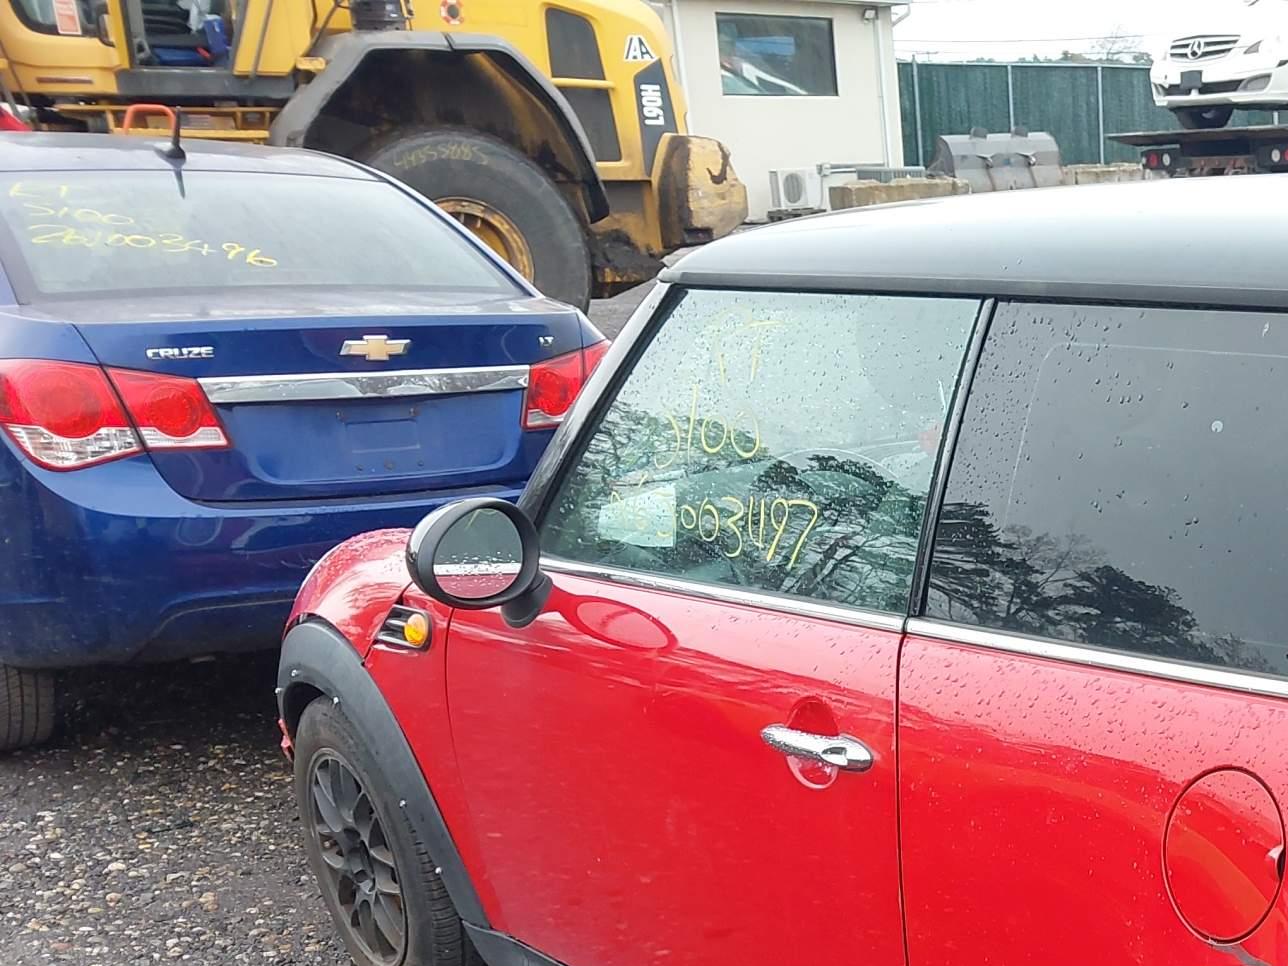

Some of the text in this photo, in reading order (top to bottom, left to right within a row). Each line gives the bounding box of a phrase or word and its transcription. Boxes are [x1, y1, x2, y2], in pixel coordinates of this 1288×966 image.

[640, 84, 665, 126] L90H
[538, 336, 555, 347] LT
[146, 346, 216, 360] CRUZE
